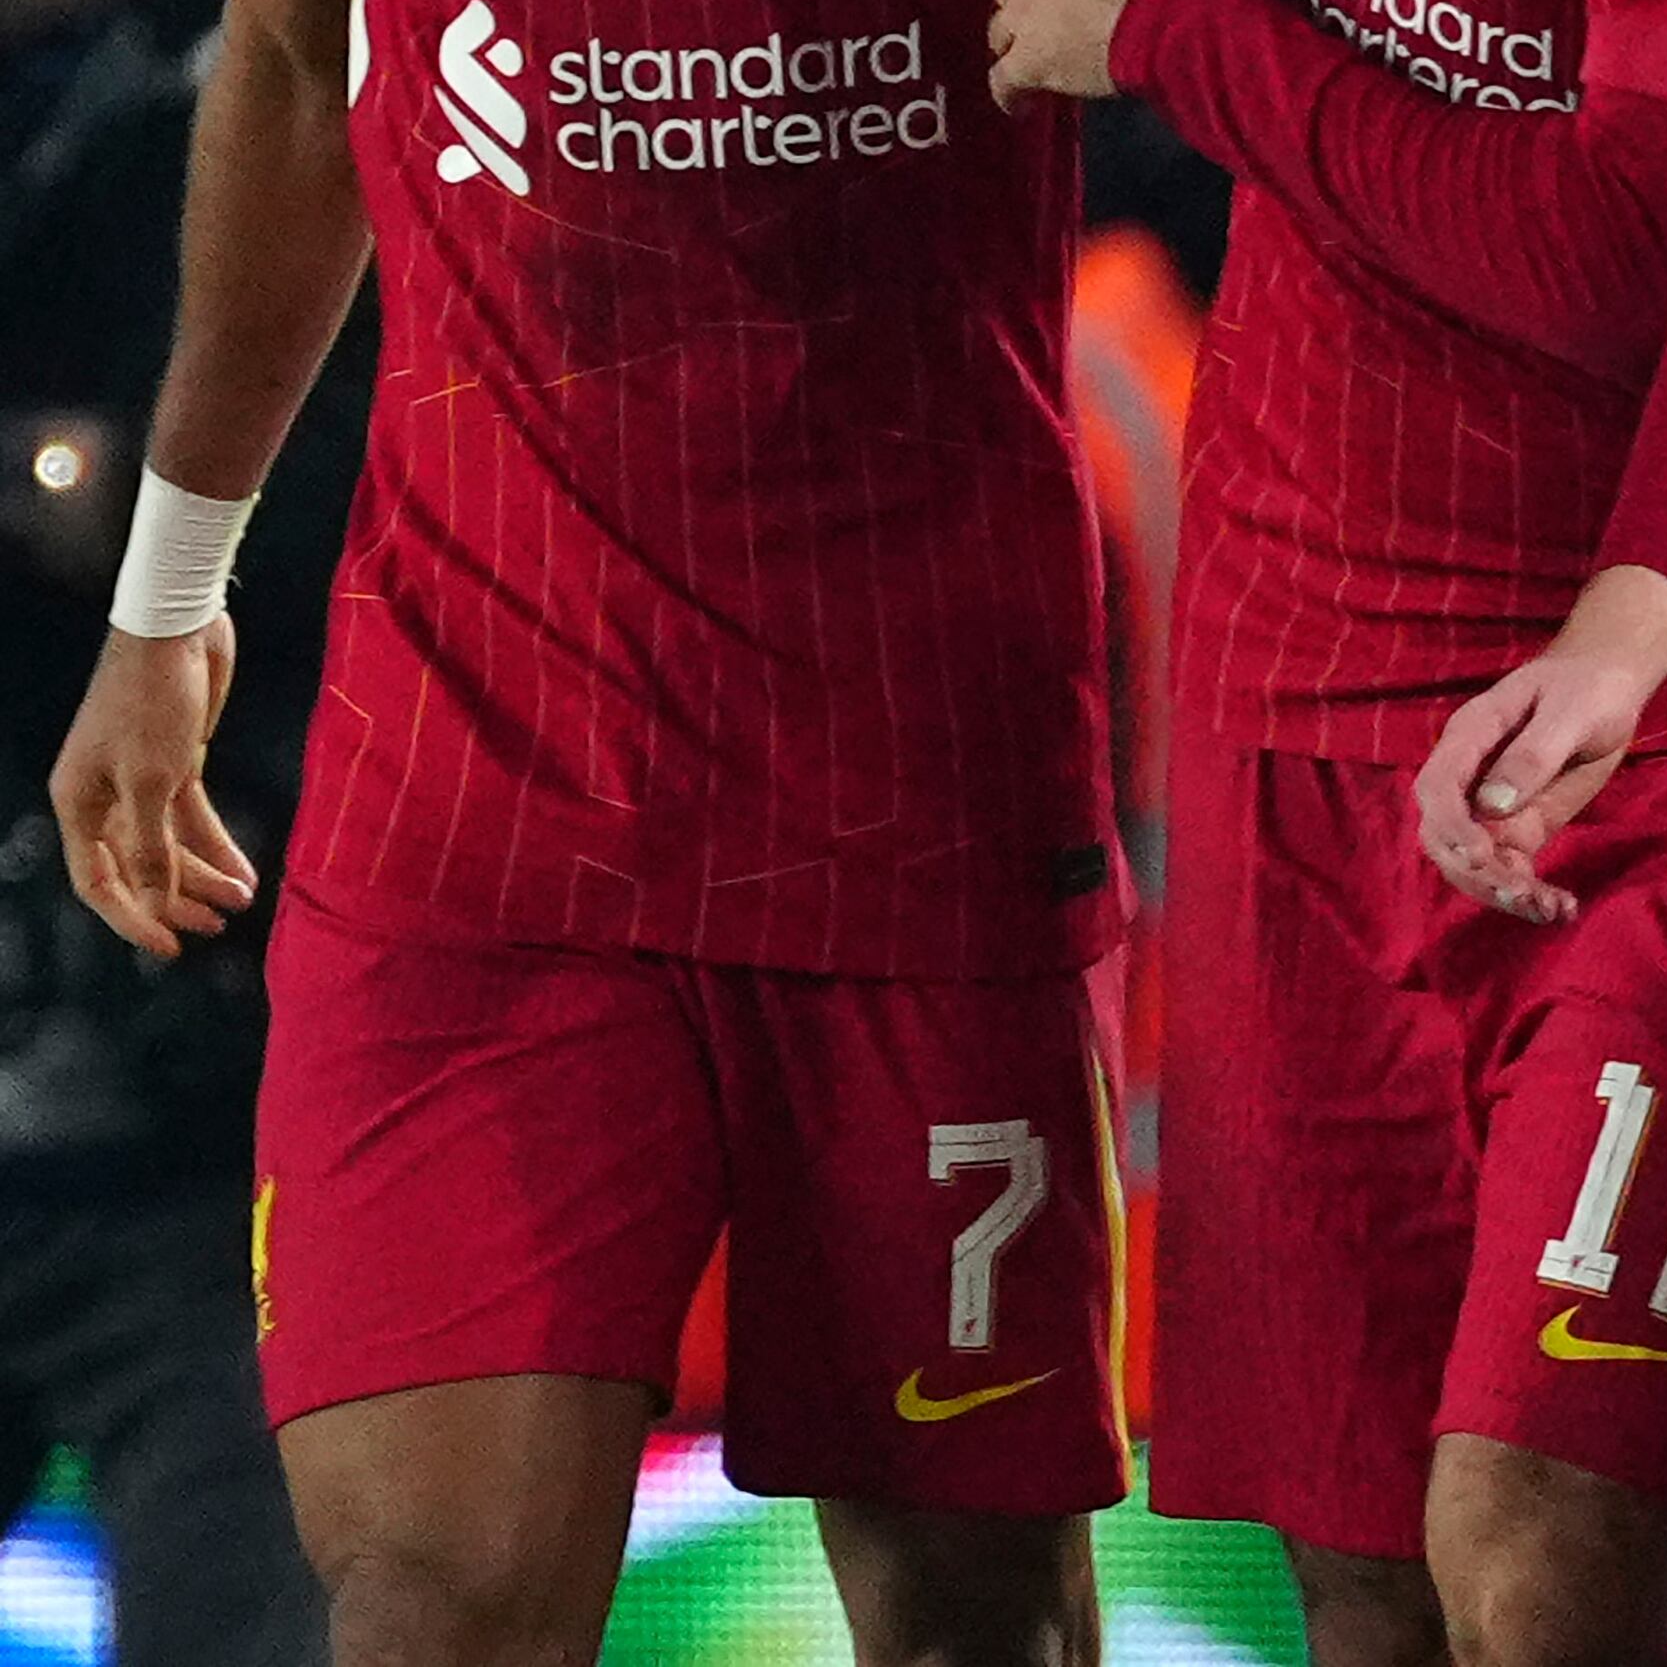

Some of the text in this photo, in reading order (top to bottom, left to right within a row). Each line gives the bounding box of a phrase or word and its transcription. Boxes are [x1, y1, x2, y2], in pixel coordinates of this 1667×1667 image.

[548, 20, 922, 105] standard
[555, 84, 948, 173] chartered
[928, 1117, 1048, 1352] 7
